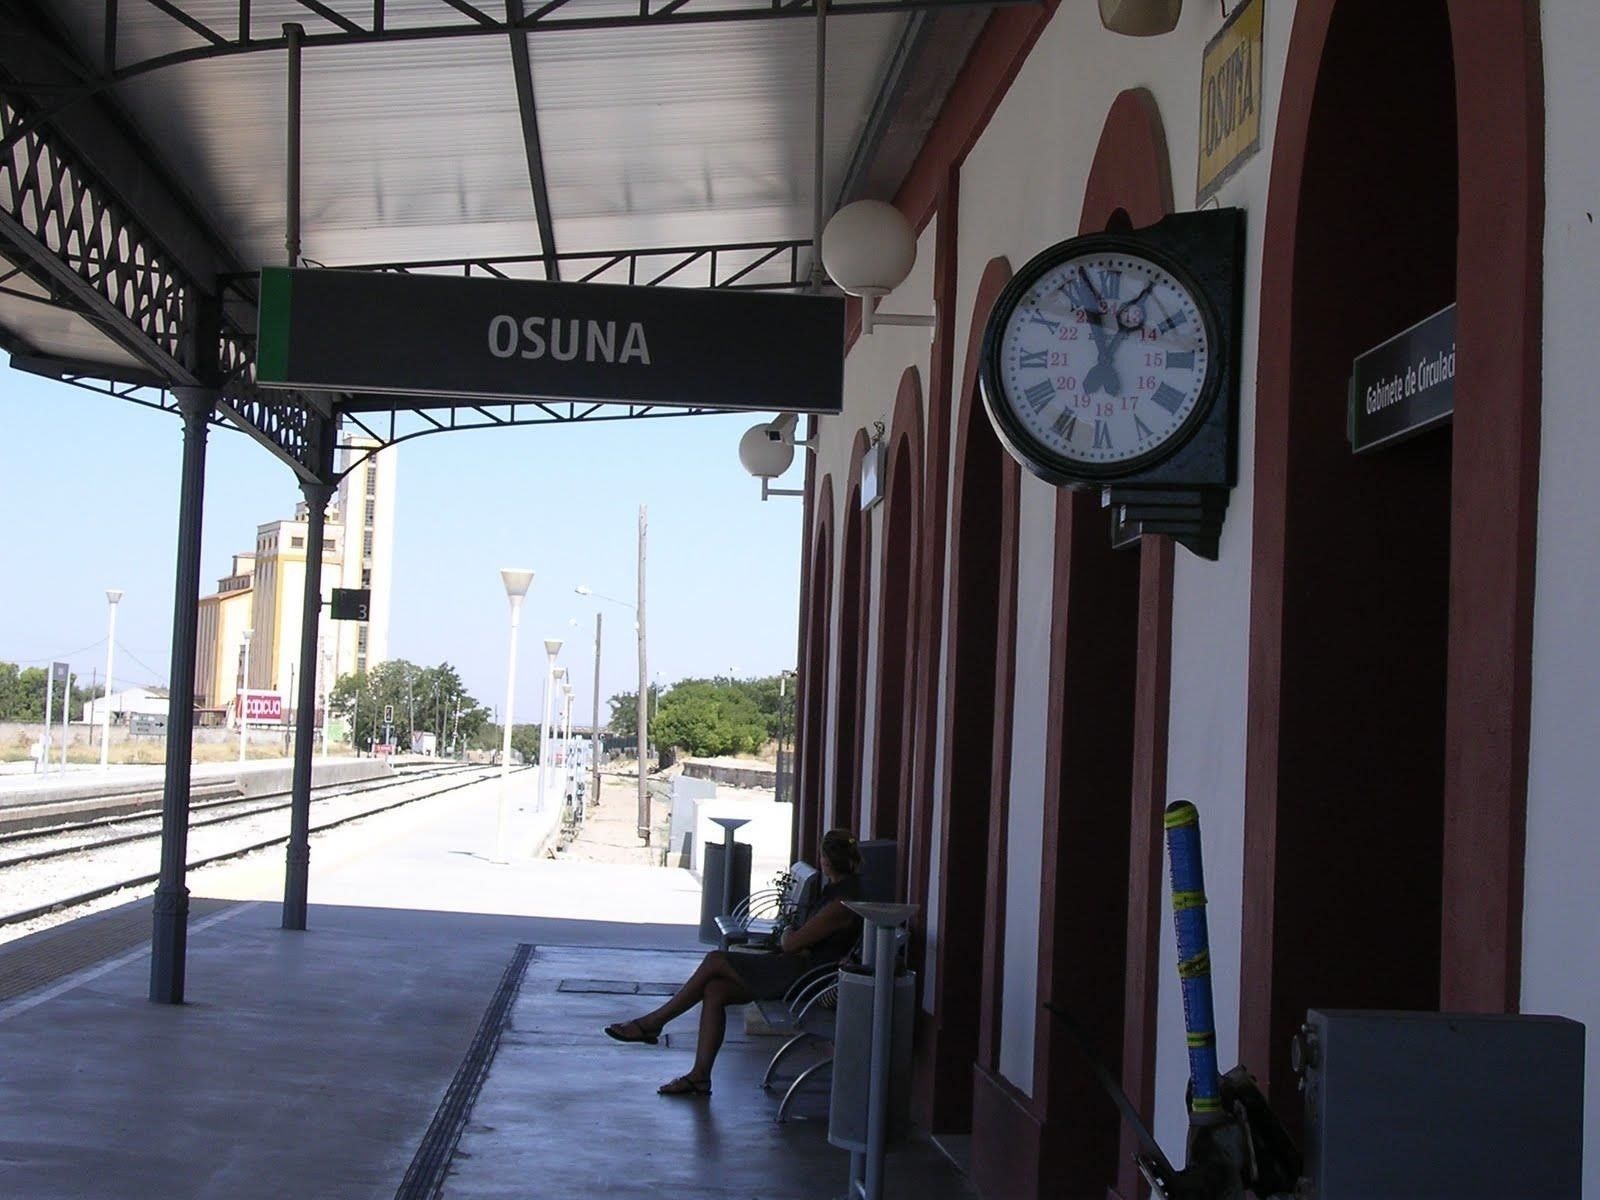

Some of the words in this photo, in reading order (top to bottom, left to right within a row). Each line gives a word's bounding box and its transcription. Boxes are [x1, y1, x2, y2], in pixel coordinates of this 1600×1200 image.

[1206, 38, 1254, 157] OSUNA
[1099, 270, 1122, 300] XII
[1029, 310, 1060, 334] X
[488, 314, 652, 365] OSUNA
[1058, 326, 1078, 341] 22
[1139, 327, 1157, 341] 14
[1019, 346, 1049, 370] IX
[1050, 352, 1068, 366] 21
[1144, 352, 1163, 367] 15
[1056, 376, 1076, 391] 20
[1136, 375, 1156, 389] 16
[1366, 374, 1403, 415] Gabinete
[1404, 366, 1416, 398] de
[1072, 394, 1092, 409] 19
[1120, 396, 1139, 410] 17
[1095, 403, 1113, 417] 18
[1133, 413, 1154, 441] V
[358, 604, 368, 620] 3
